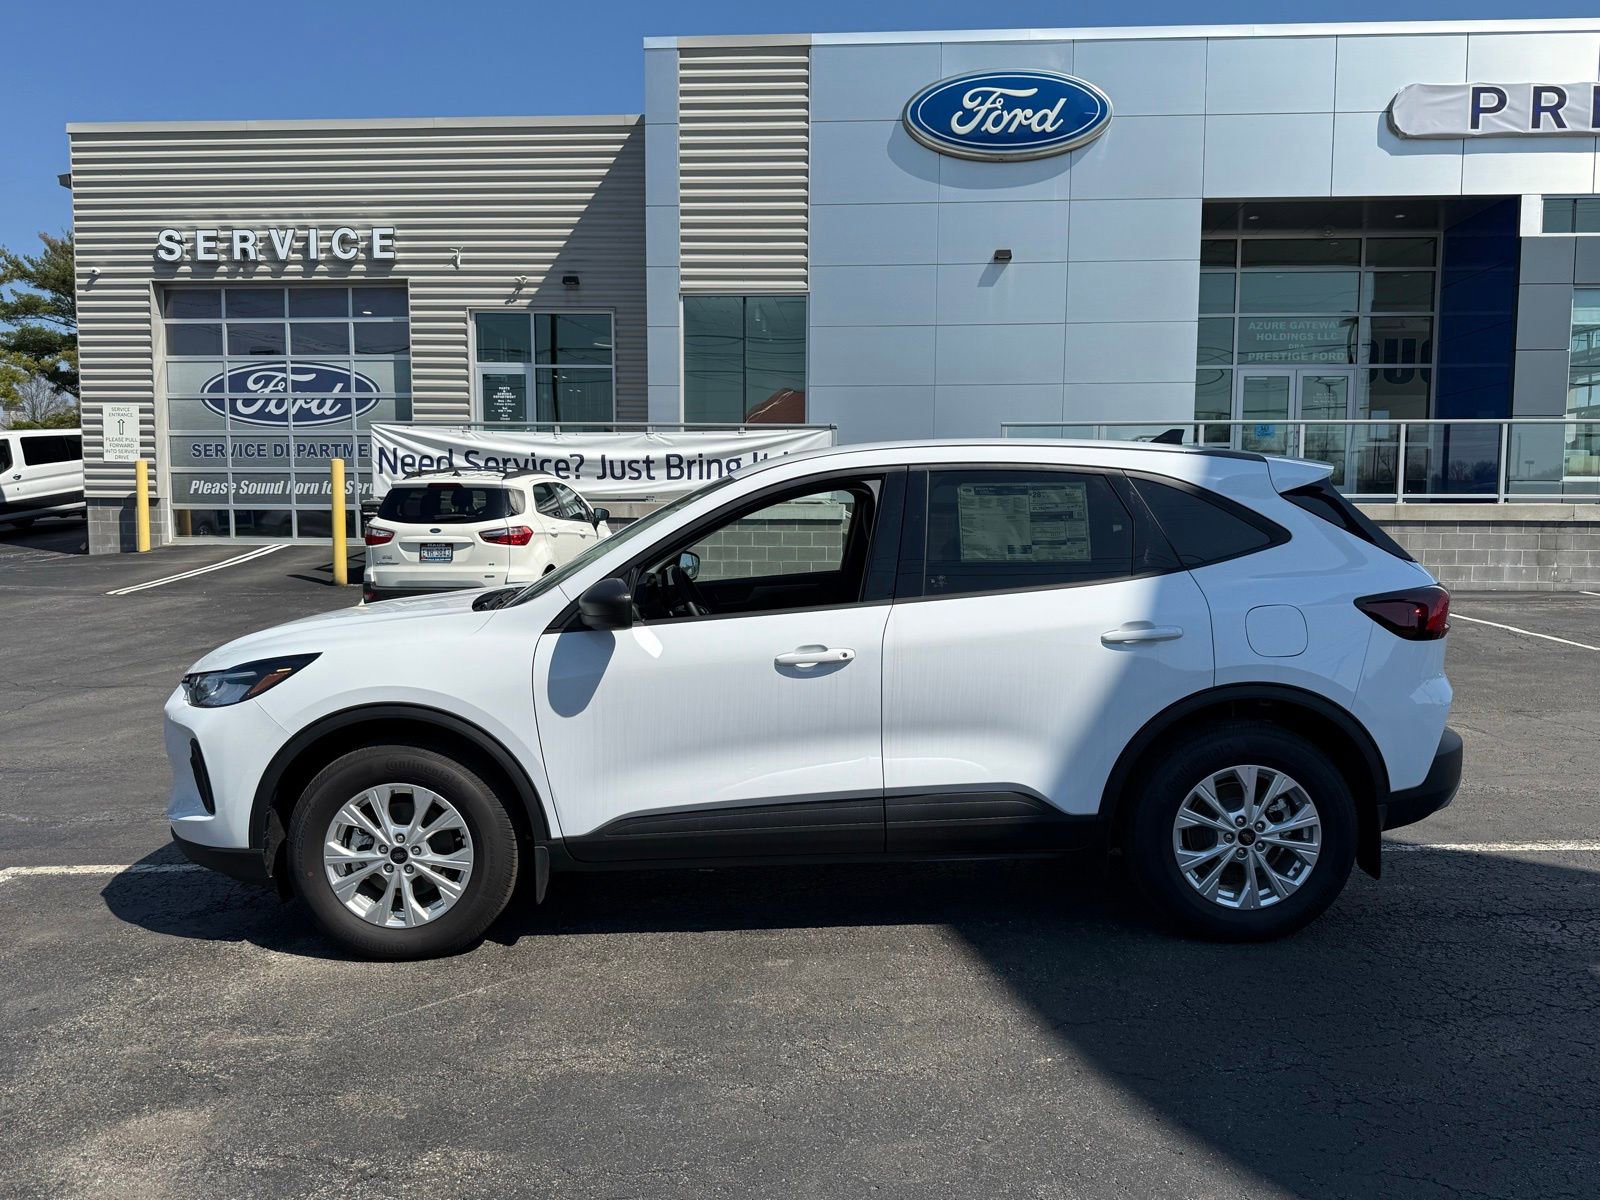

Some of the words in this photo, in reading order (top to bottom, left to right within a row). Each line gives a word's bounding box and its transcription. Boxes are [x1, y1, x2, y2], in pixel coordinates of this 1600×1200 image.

[950, 87, 1067, 135] Ford
[157, 227, 396, 262] SERVICE
[1248, 321, 1286, 330] AZURE
[1256, 332, 1314, 341] HOLDINGS
[1317, 332, 1338, 341] LLC
[1248, 352, 1309, 361] PRESTIGE
[1313, 352, 1346, 361] FORD
[236, 371, 344, 415] Ford
[378, 447, 455, 476] Need
[596, 453, 656, 481] Just
[665, 453, 743, 481] Bring
[189, 480, 237, 495] Please
[239, 480, 285, 495] Sound
